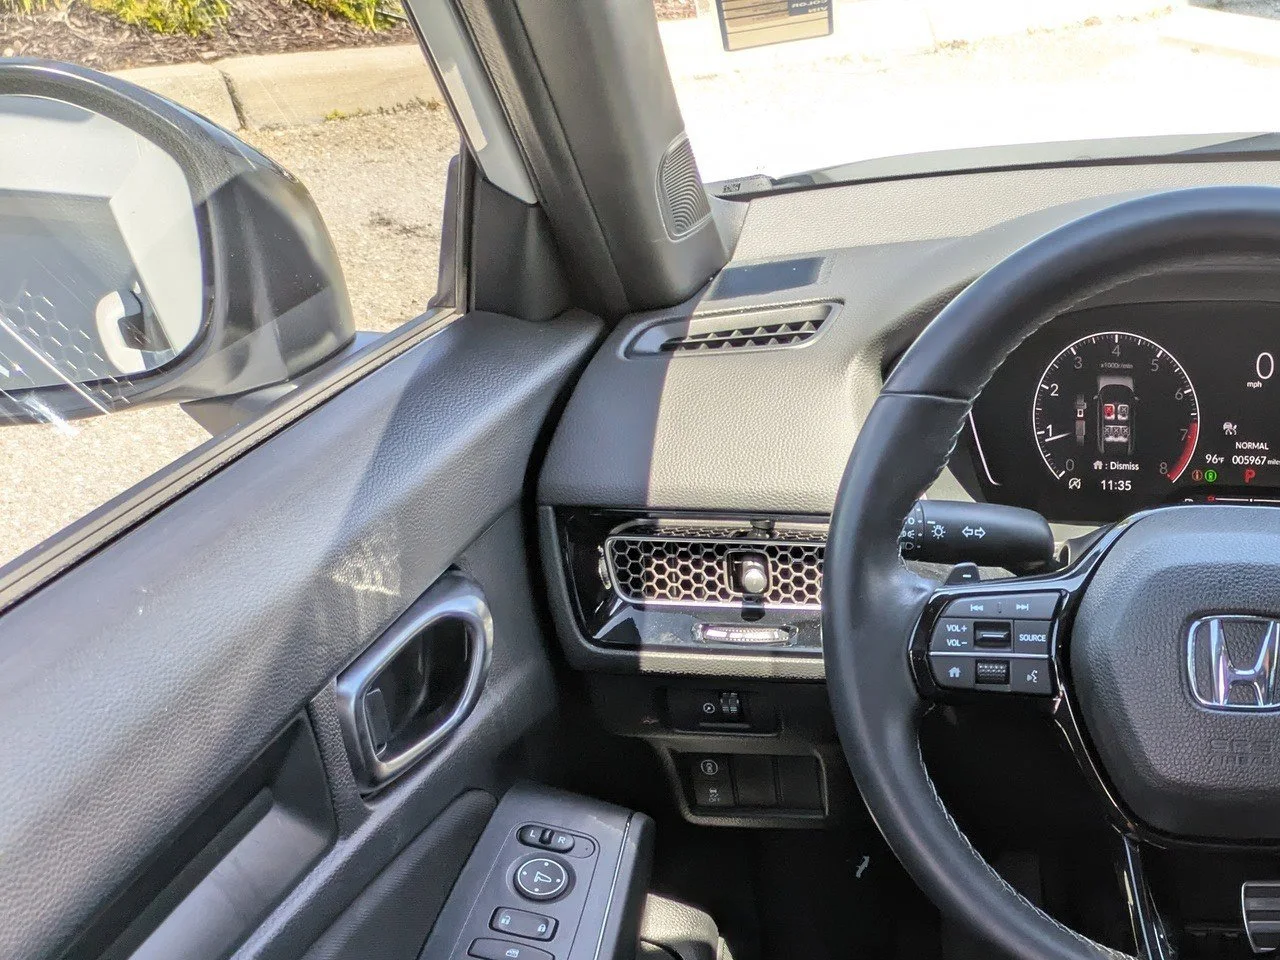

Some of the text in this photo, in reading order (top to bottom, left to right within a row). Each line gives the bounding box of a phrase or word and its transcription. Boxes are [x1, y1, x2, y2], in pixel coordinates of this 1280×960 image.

[1111, 345, 1121, 357] 4
[1074, 357, 1083, 369] 3
[1151, 359, 1159, 372] 5
[1256, 352, 1274, 379] 0
[1050, 383, 1059, 397] 2
[1246, 381, 1263, 389] mph
[1175, 387, 1183, 400] 6
[1046, 424, 1053, 437] 1
[1180, 429, 1188, 441] 7
[1235, 441, 1269, 451] NORMAL
[1066, 459, 1074, 471] 0
[1110, 461, 1140, 471] Dismiss
[1232, 455, 1267, 465] 005967
[1160, 462, 1168, 474] 8
[1245, 469, 1256, 483] P
[1101, 480, 1132, 491] 11:35
[1019, 634, 1046, 642] SOURCE
[530, 830, 536, 838] L
[557, 836, 566, 844] R
